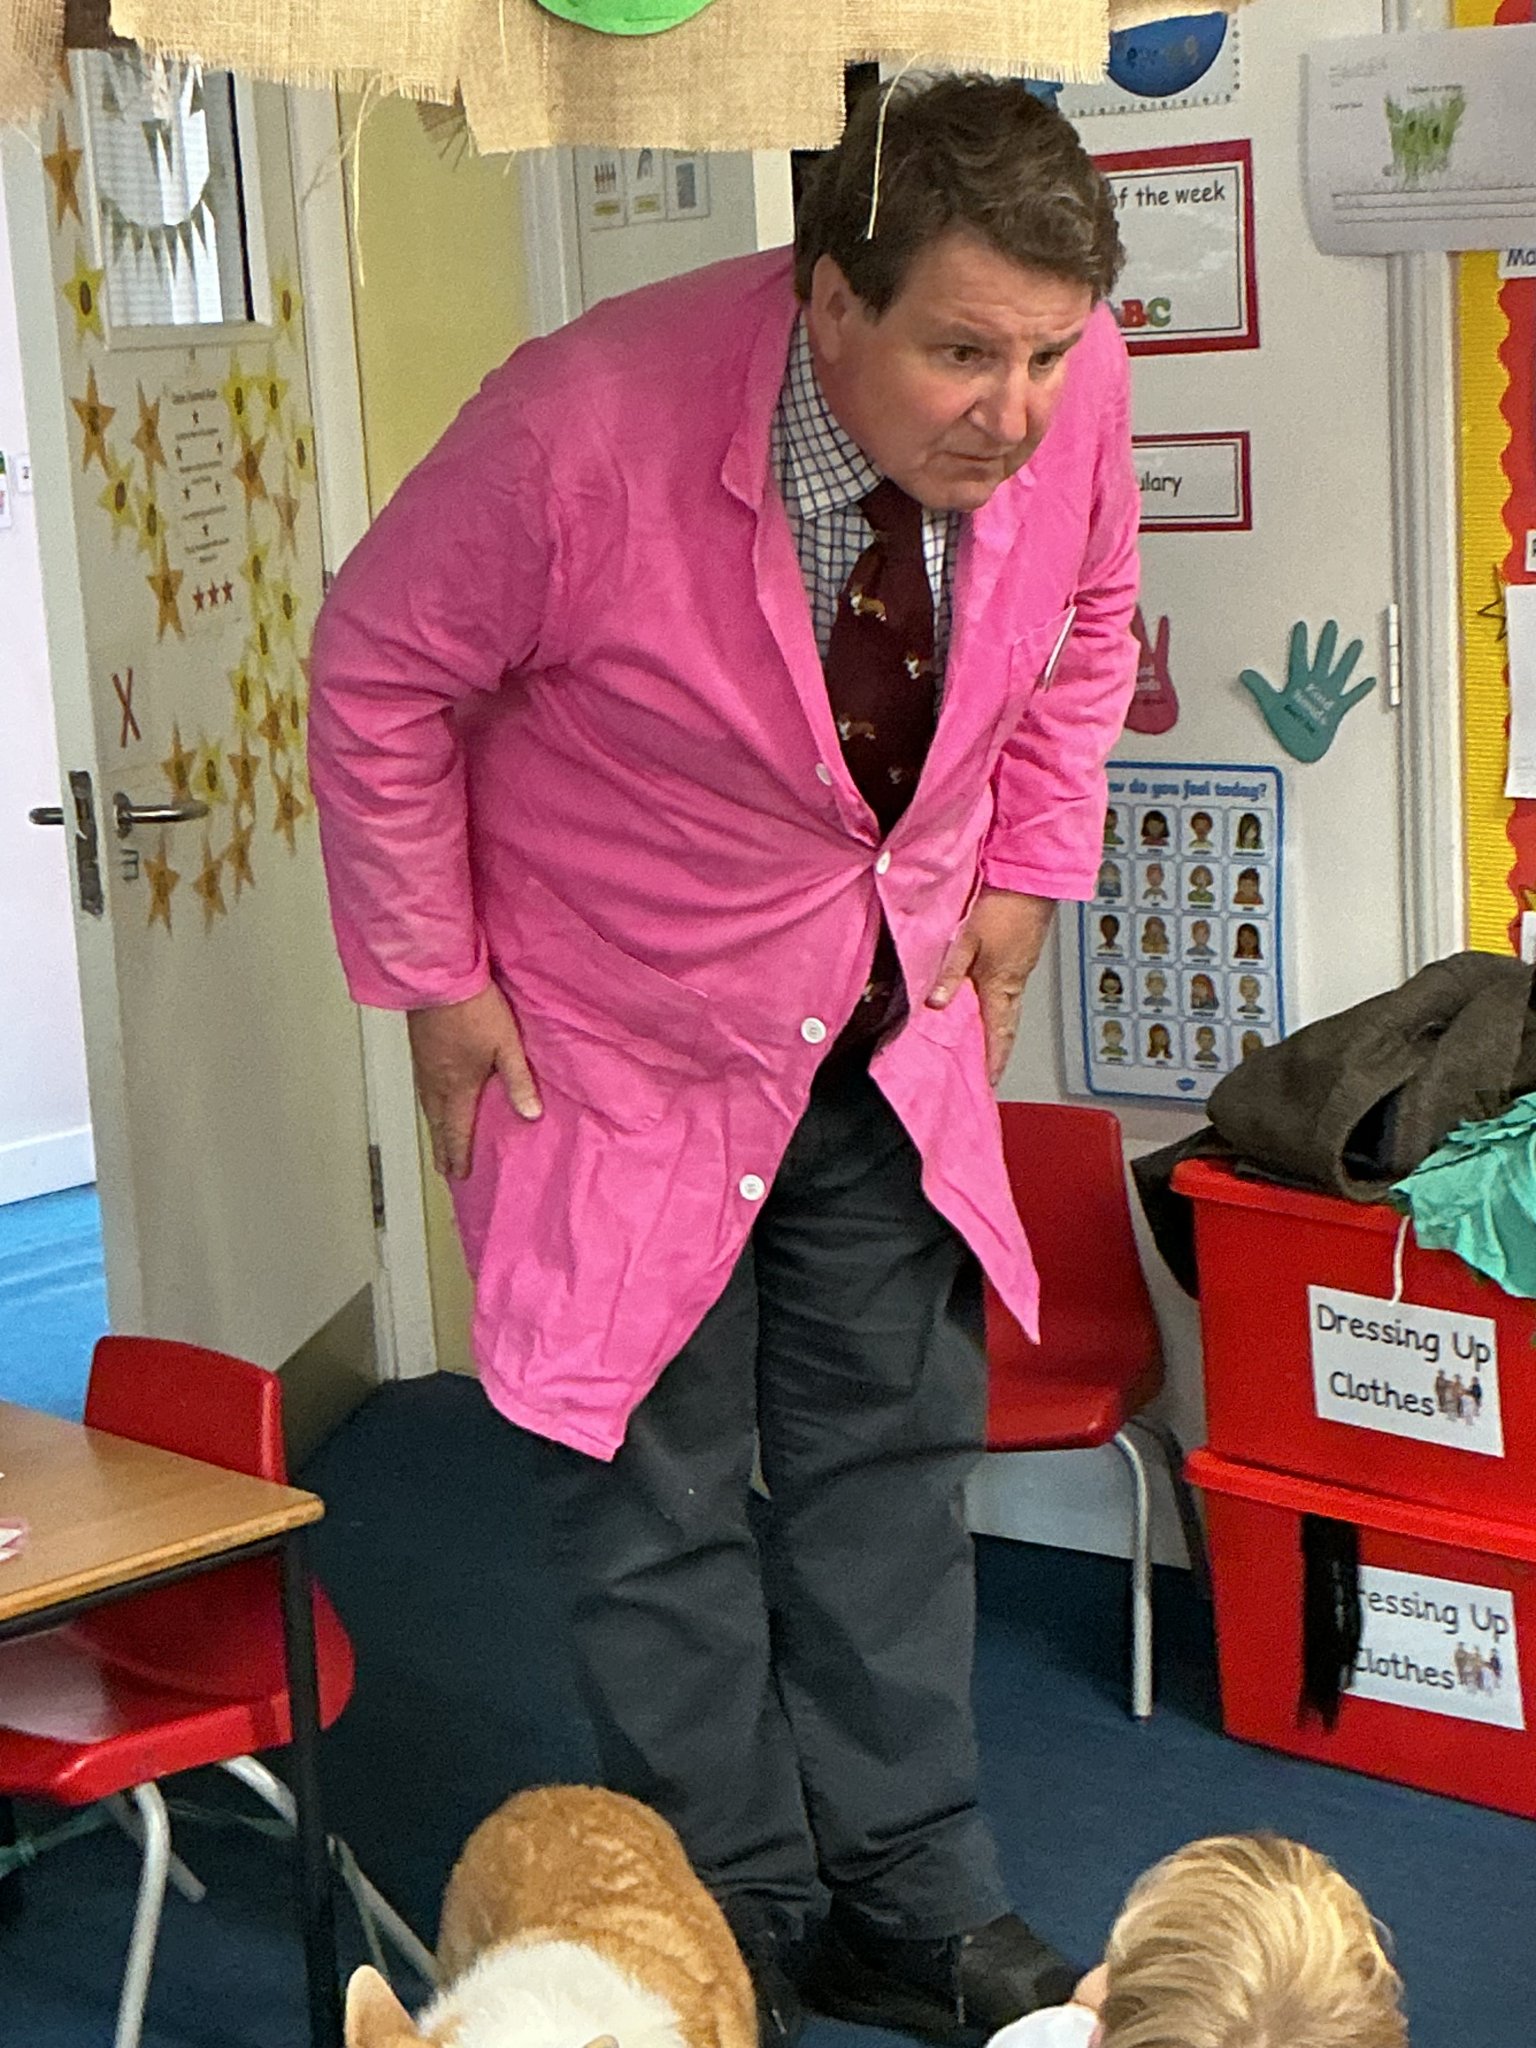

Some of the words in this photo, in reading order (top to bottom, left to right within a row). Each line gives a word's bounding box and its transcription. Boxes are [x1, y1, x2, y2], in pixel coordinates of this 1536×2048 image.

[1135, 185, 1170, 207] the
[1175, 180, 1226, 204] week
[1129, 778, 1148, 793] do
[1152, 783, 1179, 799] you
[1215, 781, 1267, 801] today?
[1317, 1303, 1440, 1362] Dressing
[1452, 1331, 1491, 1372] Up
[1330, 1371, 1435, 1416] Clothes
[1469, 1603, 1509, 1643] Up
